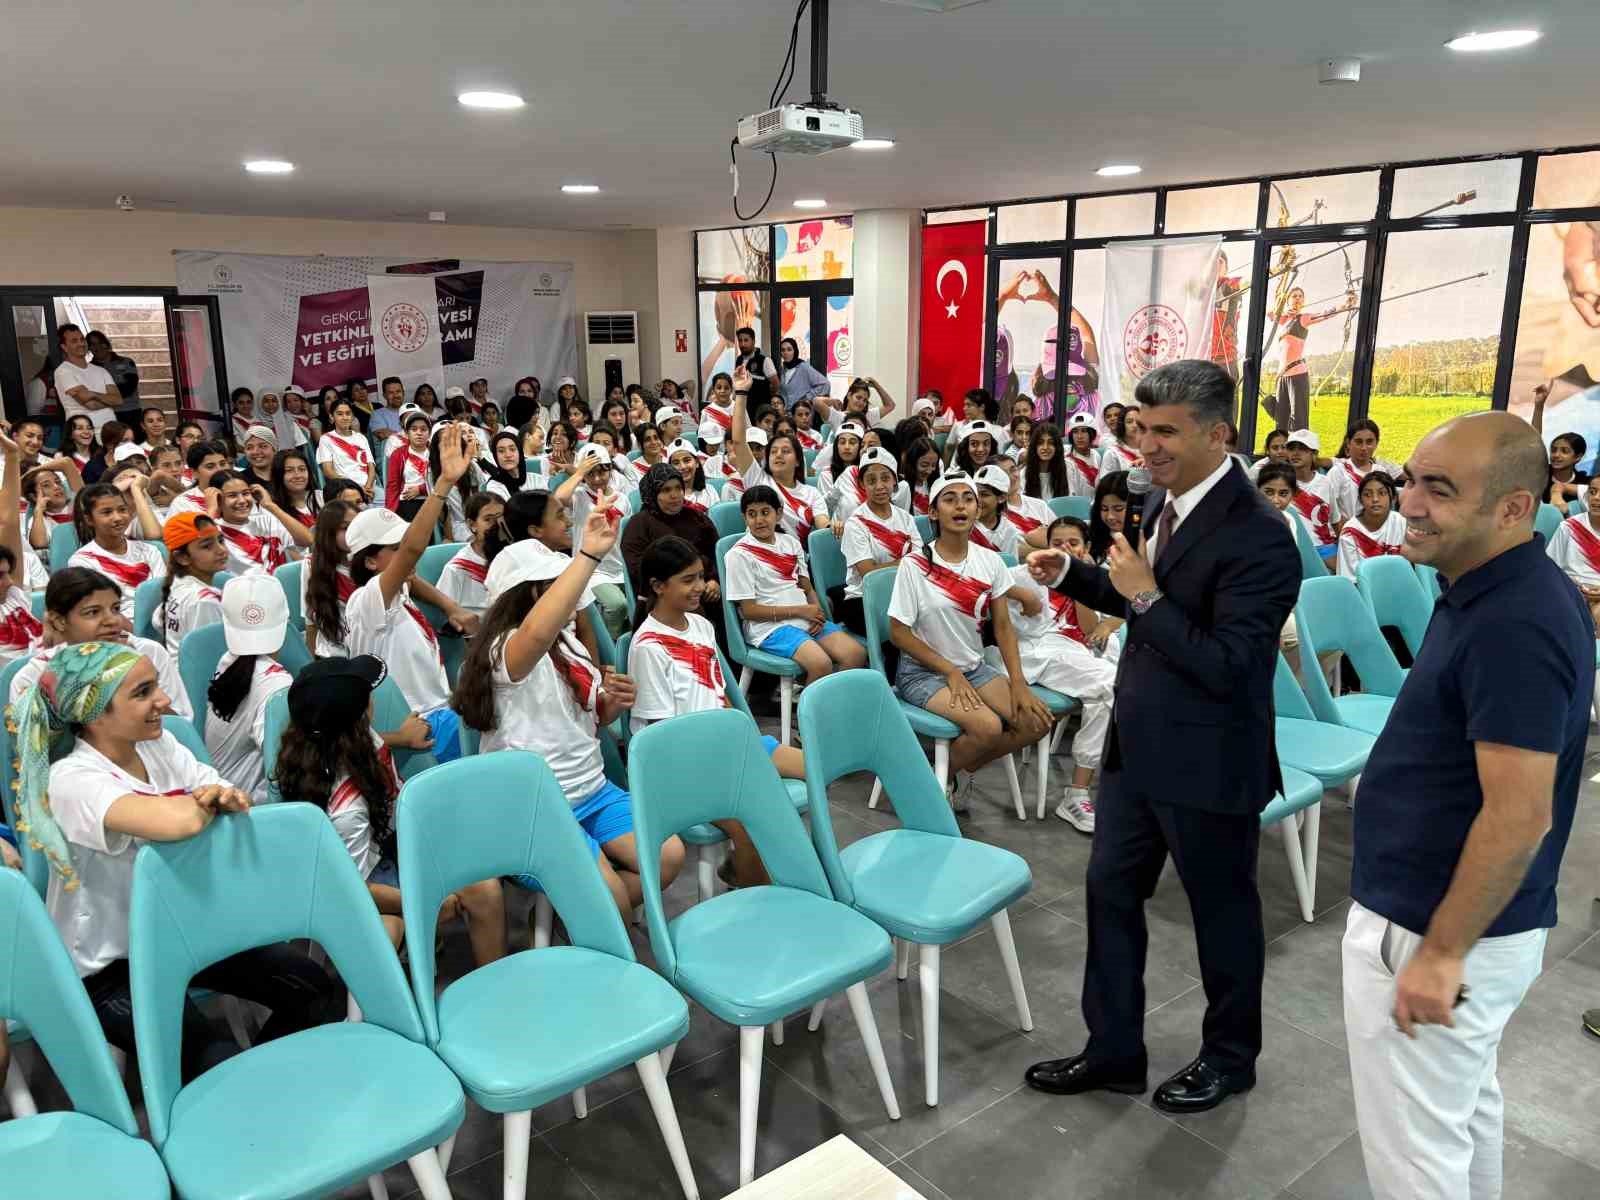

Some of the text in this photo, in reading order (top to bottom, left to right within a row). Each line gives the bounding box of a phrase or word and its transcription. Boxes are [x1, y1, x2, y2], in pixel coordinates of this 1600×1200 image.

[301, 325, 371, 347] YETKİNL
[439, 305, 472, 324] VESİ
[320, 307, 371, 326] GENÇLİ
[300, 352, 322, 367] VE
